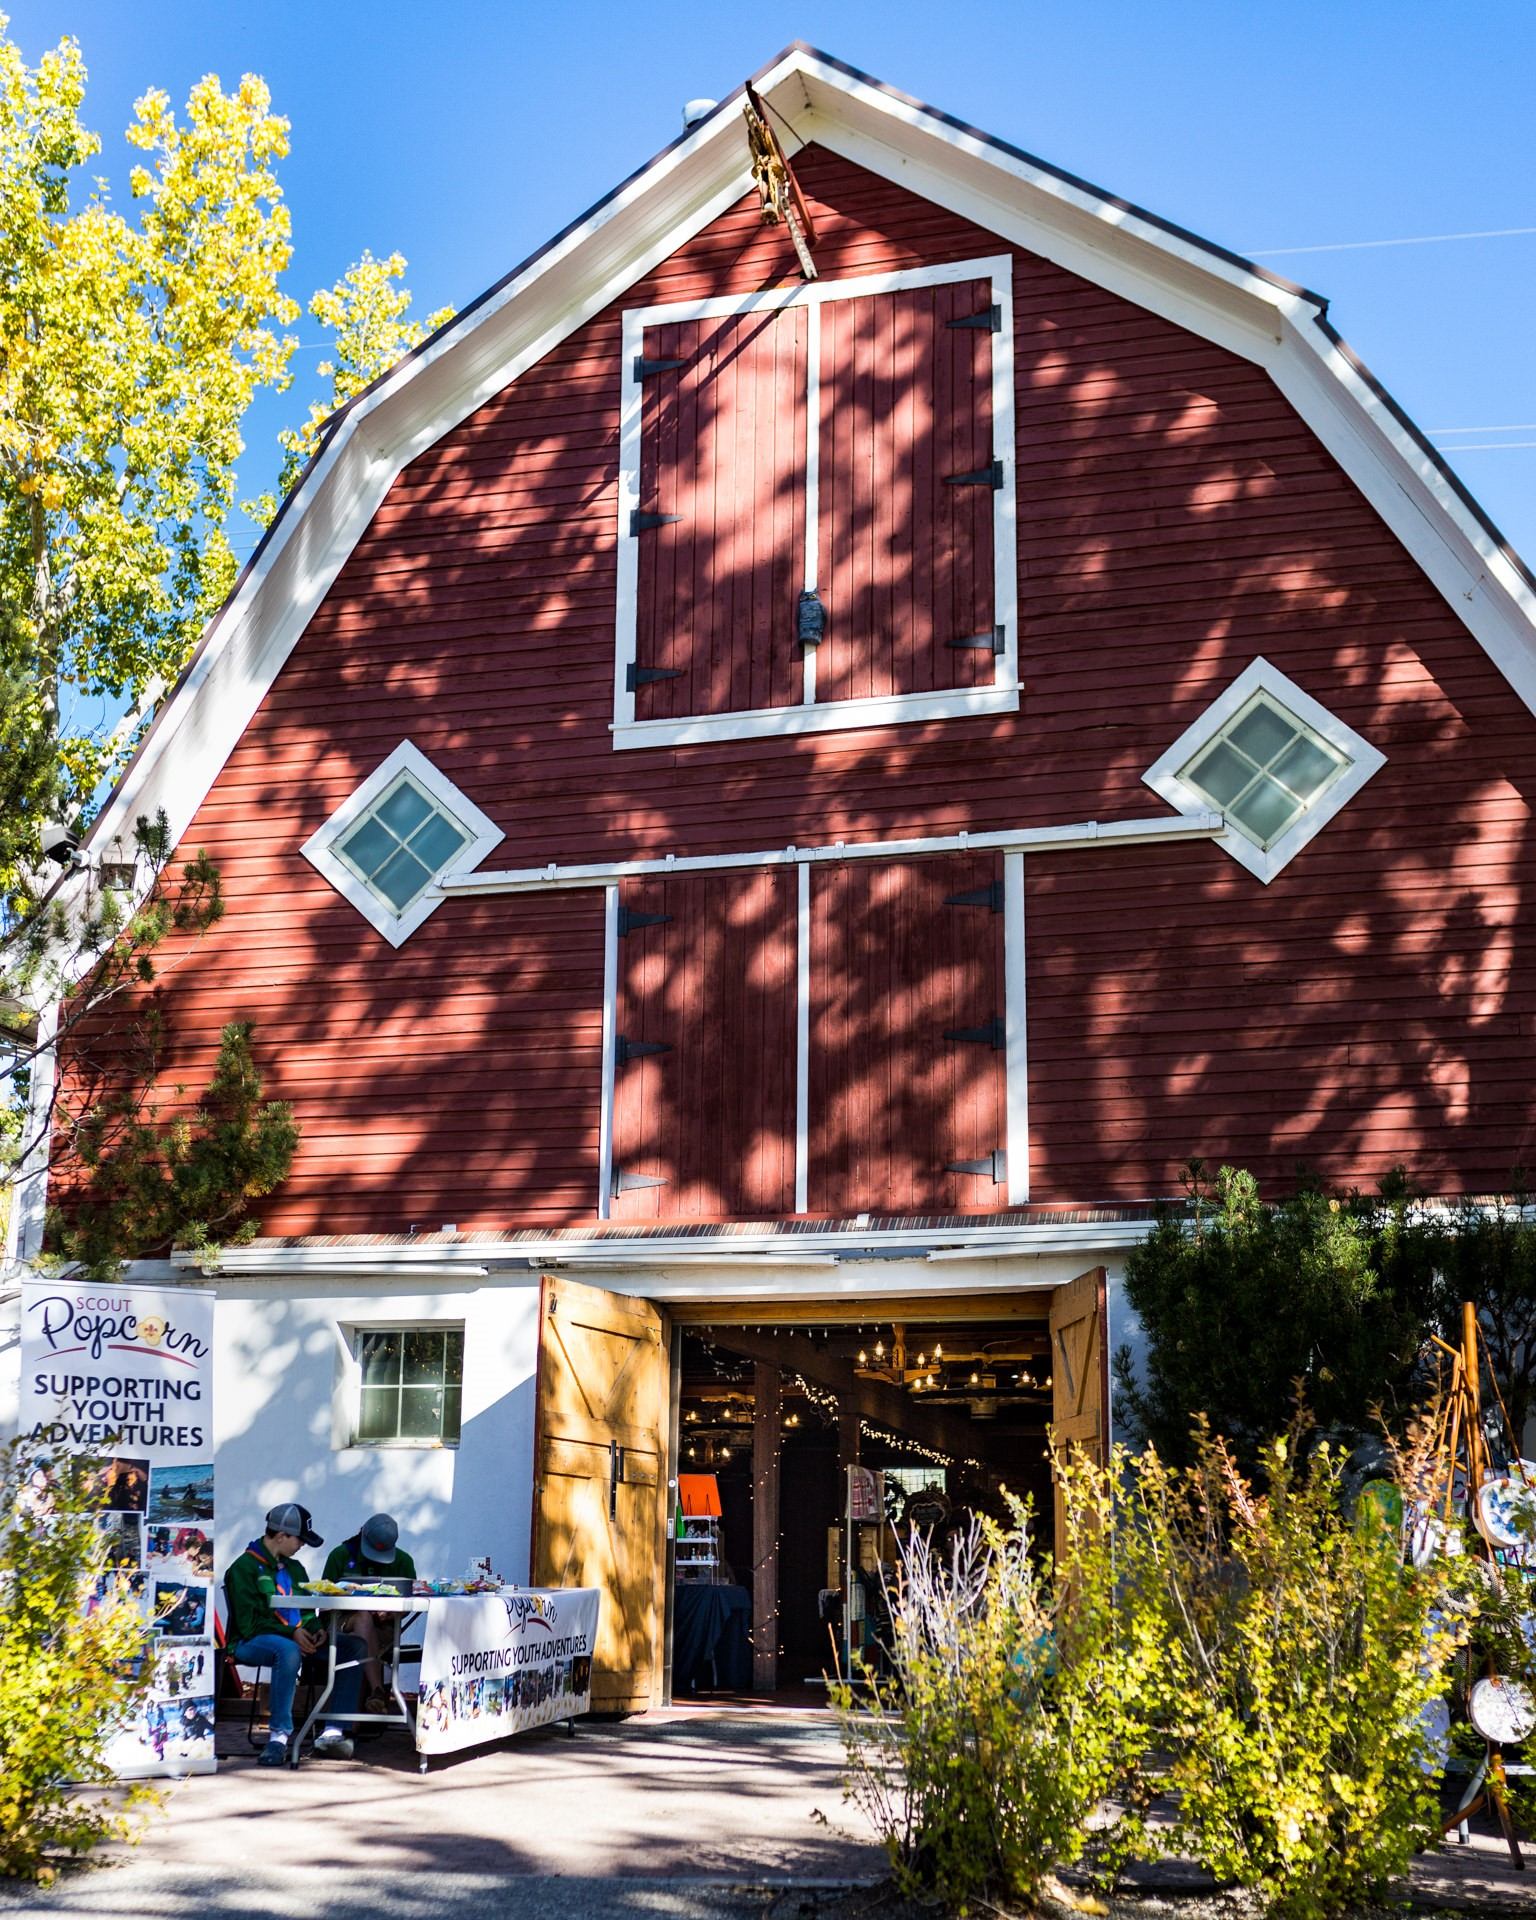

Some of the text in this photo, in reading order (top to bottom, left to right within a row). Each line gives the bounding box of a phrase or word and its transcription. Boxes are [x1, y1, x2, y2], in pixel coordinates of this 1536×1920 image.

[76, 1297, 133, 1313] SCOUT
[34, 1374, 201, 1400] SUPPORTING
[72, 1400, 165, 1423] YOUTH
[30, 1422, 204, 1447] ADVENTURES
[451, 1634, 587, 1676] SUPPORTING YOUTH ADVENTURES
